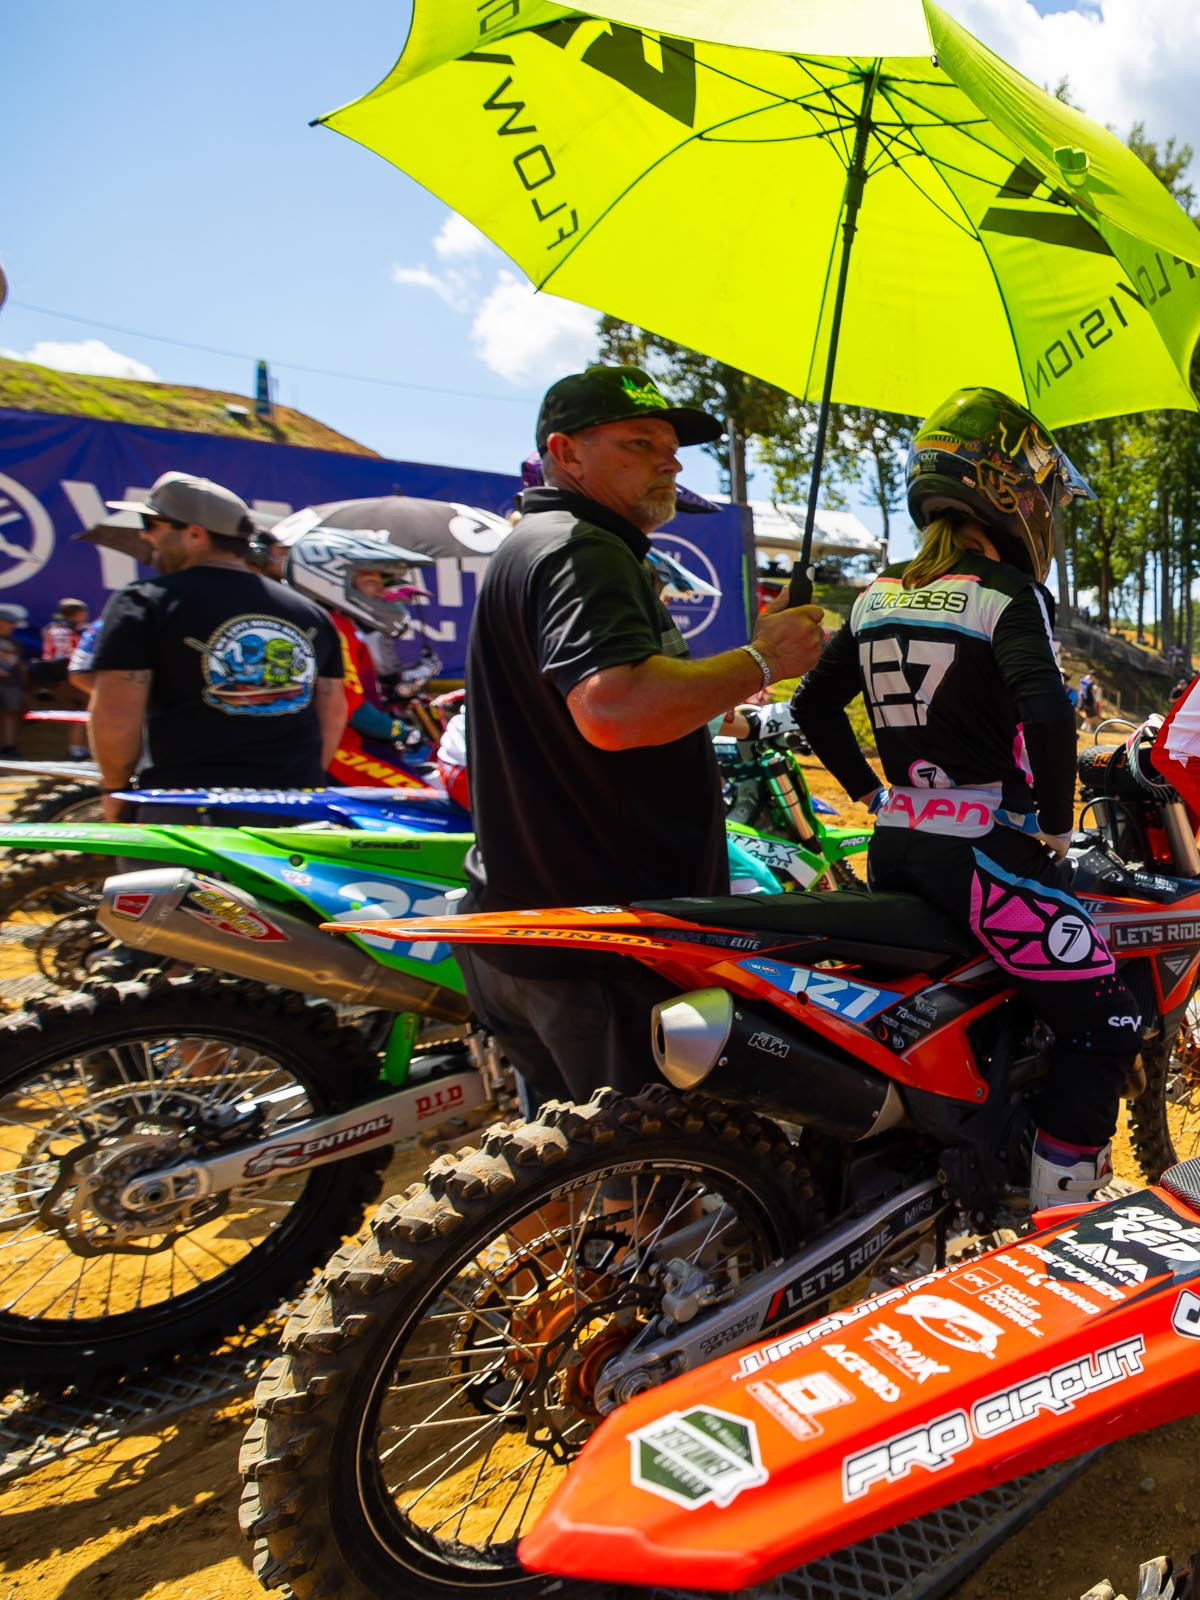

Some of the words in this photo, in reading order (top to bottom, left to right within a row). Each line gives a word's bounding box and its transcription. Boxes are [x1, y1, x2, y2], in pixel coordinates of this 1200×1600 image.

[858, 637, 956, 728] 127
[502, 928, 673, 949] DUNLOP
[729, 937, 761, 951] ELITE
[789, 967, 880, 1019] 127
[748, 1032, 790, 1058] KTM
[245, 1116, 393, 1176] RENTHAL
[850, 1232, 893, 1272] RIDE
[1017, 1243, 1126, 1300] FIREPOWER
[1056, 1230, 1148, 1283] LAVA
[1062, 1244, 1140, 1288] PROPANE
[989, 1290, 1042, 1320] POWDER
[995, 1254, 1036, 1276] BAJA
[1043, 1281, 1101, 1315] BOUND
[999, 1284, 1040, 1306] COAST
[978, 1294, 1033, 1327] COATING
[845, 1411, 972, 1500] PRO
[975, 1335, 1146, 1439] CIRCUIT
